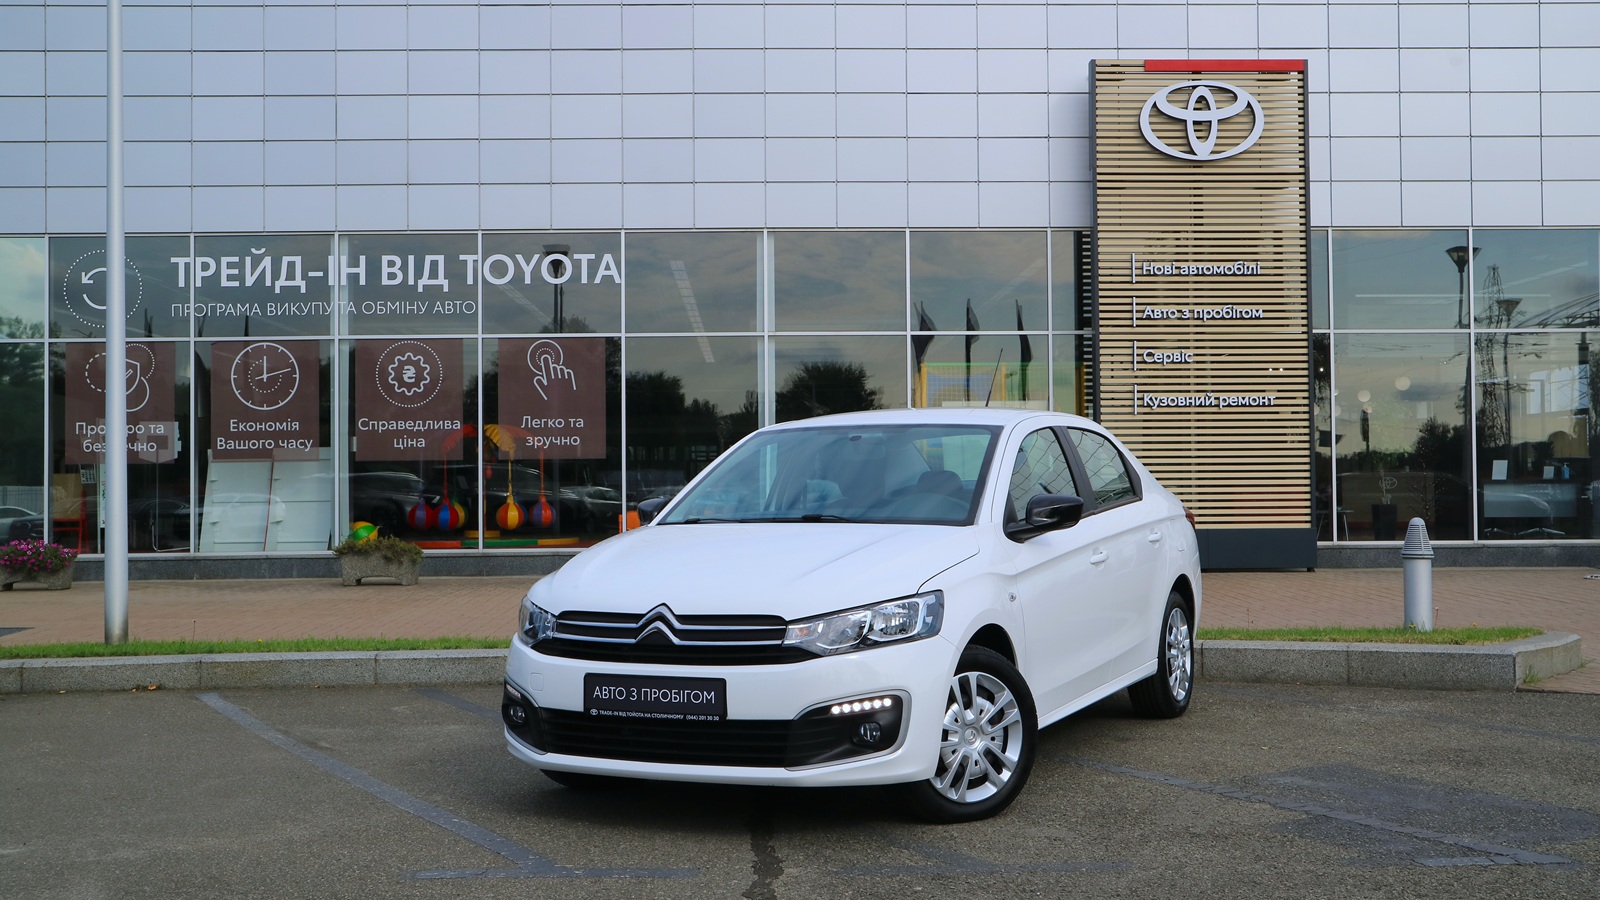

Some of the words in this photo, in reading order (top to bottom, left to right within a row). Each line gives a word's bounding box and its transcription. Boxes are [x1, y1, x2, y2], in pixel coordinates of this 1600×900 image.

[170, 247, 366, 294] ТРЕЙД-ІН
[381, 254, 449, 293] ВІД
[459, 253, 622, 285] TOYOTA
[1142, 261, 1176, 275] Нові
[1180, 261, 1261, 275] автомобілі
[171, 303, 262, 317] ПРОГРАМА
[267, 302, 334, 316] ВИКУПУ
[338, 301, 357, 315] ТА
[362, 301, 429, 315] ОБМІНУ
[433, 301, 476, 314] АВТО
[1142, 306, 1178, 319] Авто
[1181, 310, 1190, 319] з
[1194, 304, 1263, 322] пробігом
[1143, 350, 1194, 365] Сервіс
[1143, 392, 1215, 410] Кузовний
[1219, 395, 1276, 409] ремонт
[75, 422, 145, 437] Проро
[149, 424, 164, 434] та
[229, 419, 299, 431] Економія
[358, 417, 461, 433] Справедлива
[521, 415, 565, 430] Легко
[569, 417, 584, 428] та
[217, 437, 275, 450] Вашого
[279, 439, 313, 451] часу
[393, 436, 426, 449] ціна
[525, 433, 580, 449] зручно
[593, 686, 627, 700] АВТО
[641, 688, 715, 704] ПРОБІГОМ
